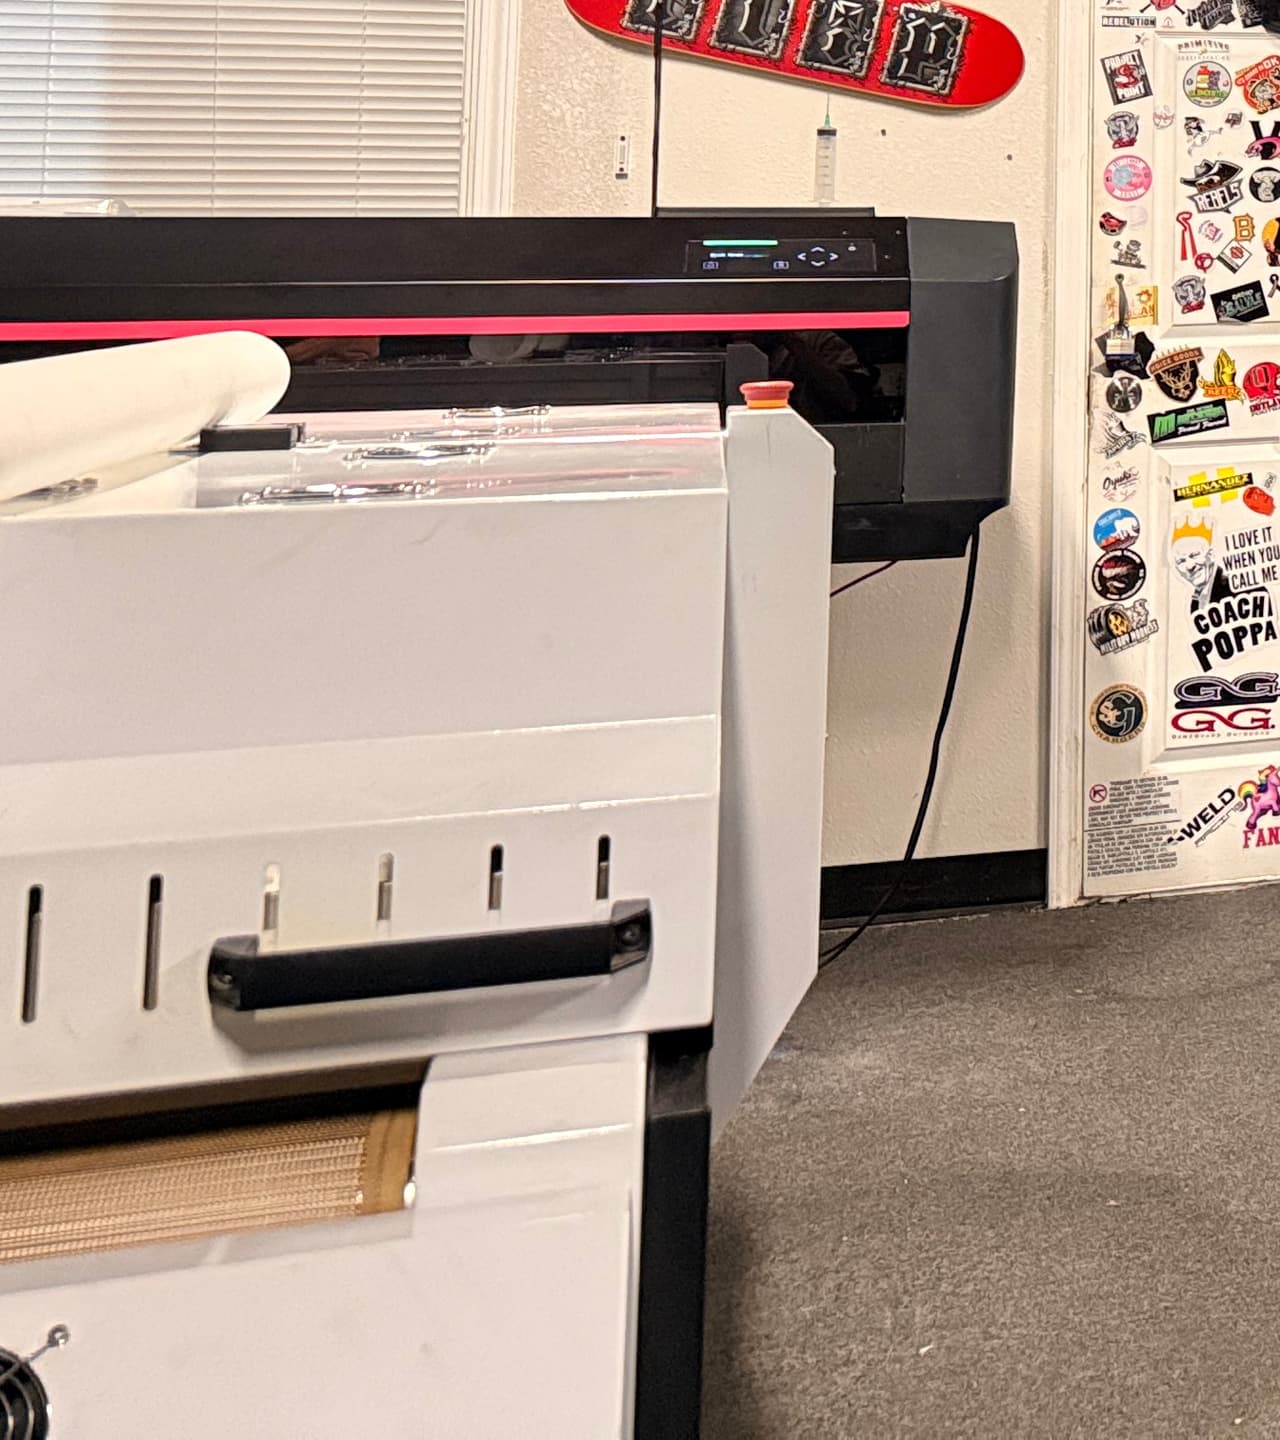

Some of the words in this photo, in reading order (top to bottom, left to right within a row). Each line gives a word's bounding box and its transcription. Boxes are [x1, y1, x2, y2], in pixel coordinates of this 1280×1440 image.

[1101, 16, 1156, 27] REBELUTION
[1177, 473, 1252, 498] HERNANDEZ
[1233, 529, 1259, 549] LOVE
[1263, 526, 1273, 543] IT
[1223, 549, 1256, 571] WHEN
[1232, 571, 1260, 591] CALL
[1262, 565, 1279, 583] ME
[1194, 595, 1267, 635] COACH
[1192, 620, 1278, 672] POPPA
[1180, 787, 1236, 840] WELD
